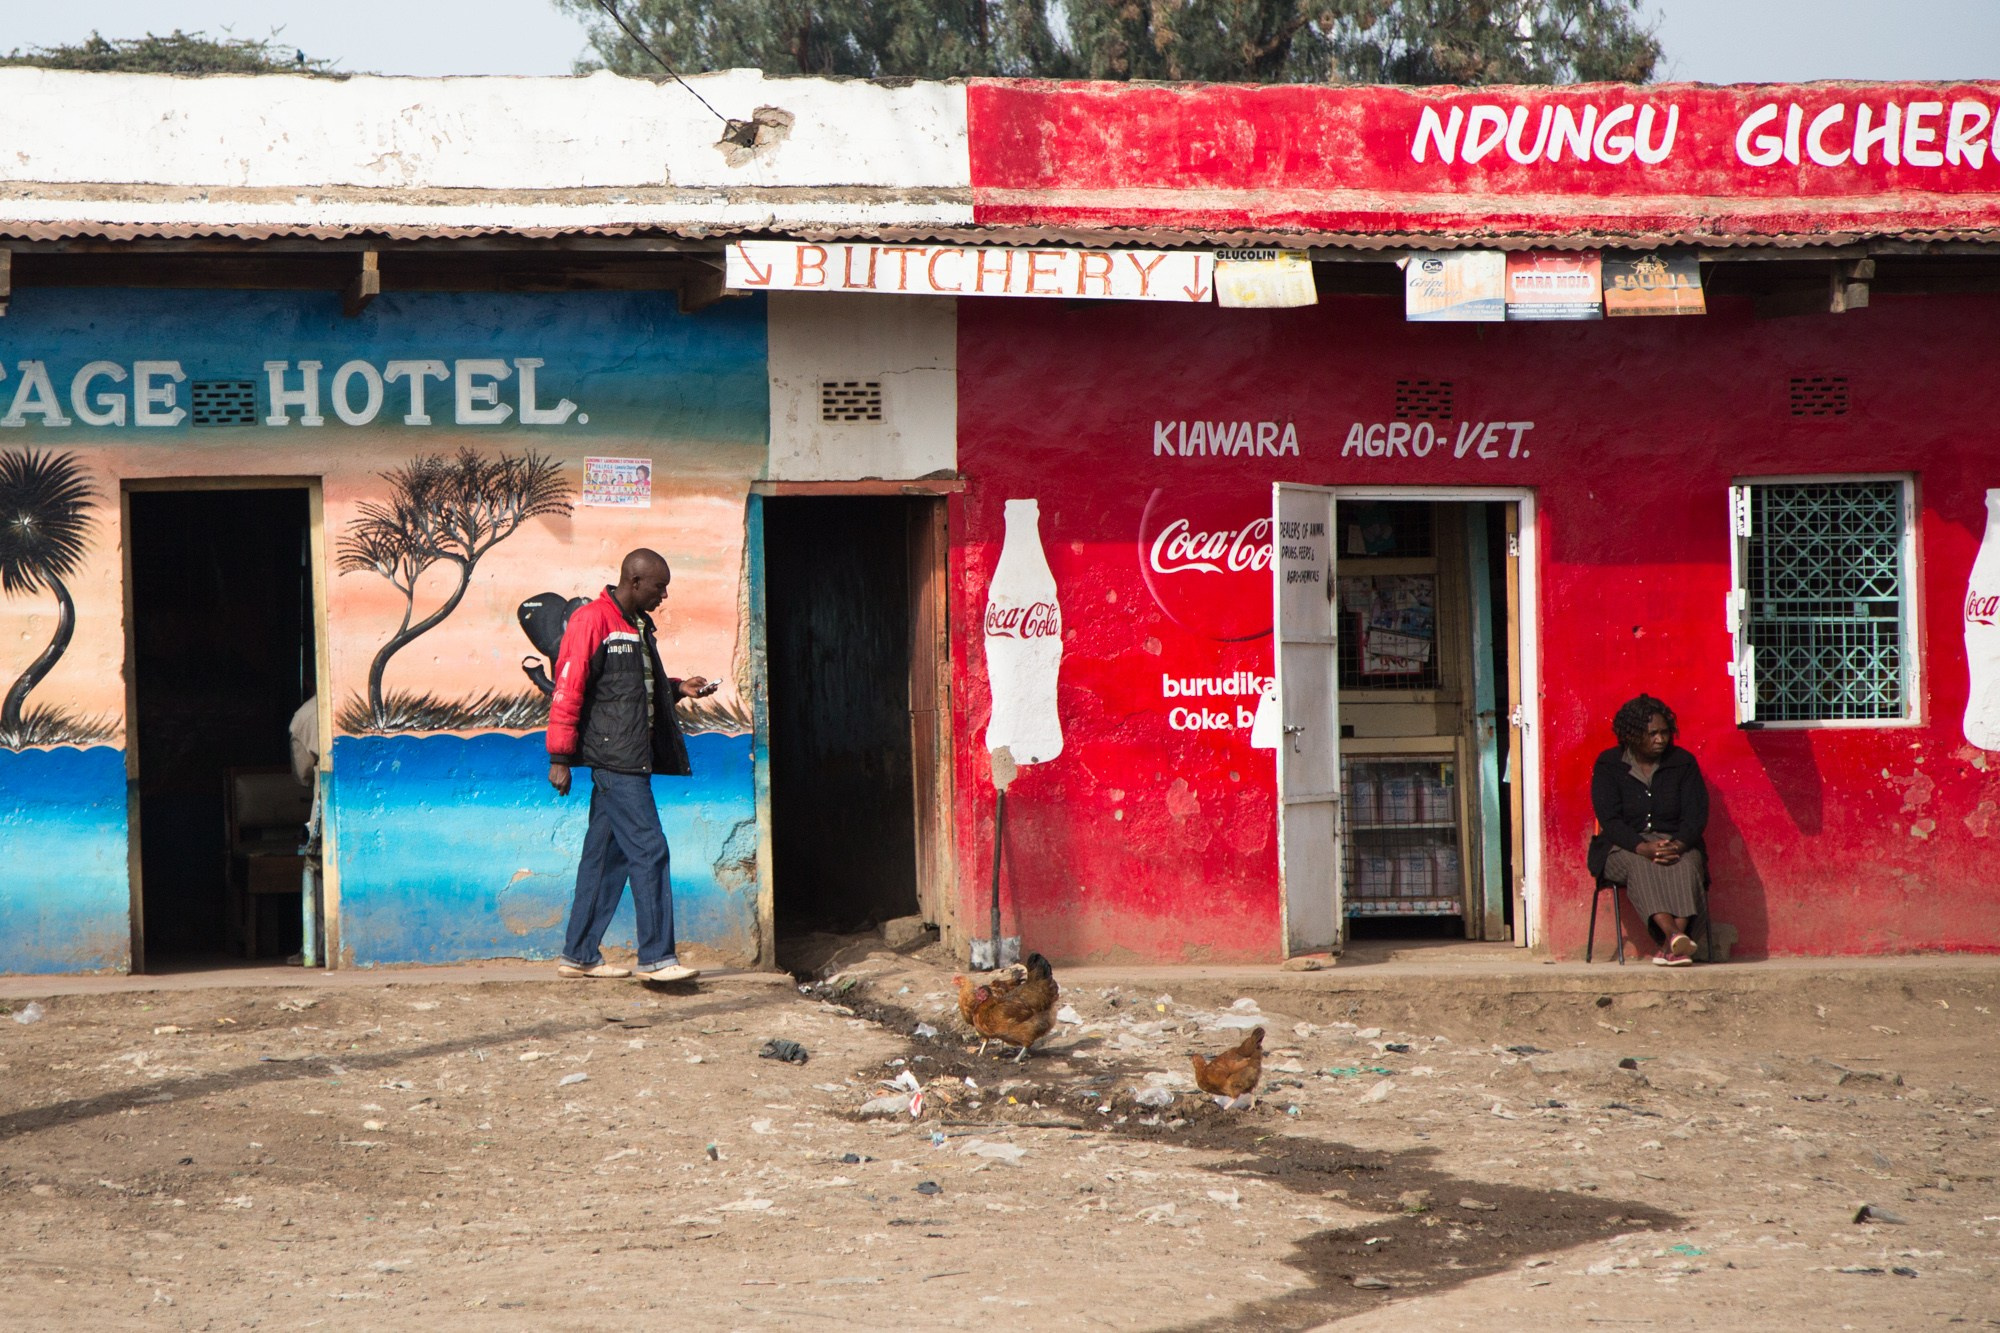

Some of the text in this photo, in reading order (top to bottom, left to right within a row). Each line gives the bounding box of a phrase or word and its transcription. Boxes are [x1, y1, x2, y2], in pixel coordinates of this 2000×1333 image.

[1411, 101, 2000, 170] NDUNGU GICHER
[793, 245, 1168, 296] BUTCHERY
[1216, 250, 1276, 260] GLUCOLIN
[1515, 275, 1591, 288] MARA MOJA
[0, 357, 589, 427] AGE HOTEL.
[1153, 420, 1300, 457] KIAWARA
[1280, 521, 1301, 540] DEALERS
[1302, 522, 1308, 540] OF
[986, 602, 1058, 639] Coca-Cola
[1966, 590, 2000, 627] Coca
[1236, 704, 1256, 729] b
